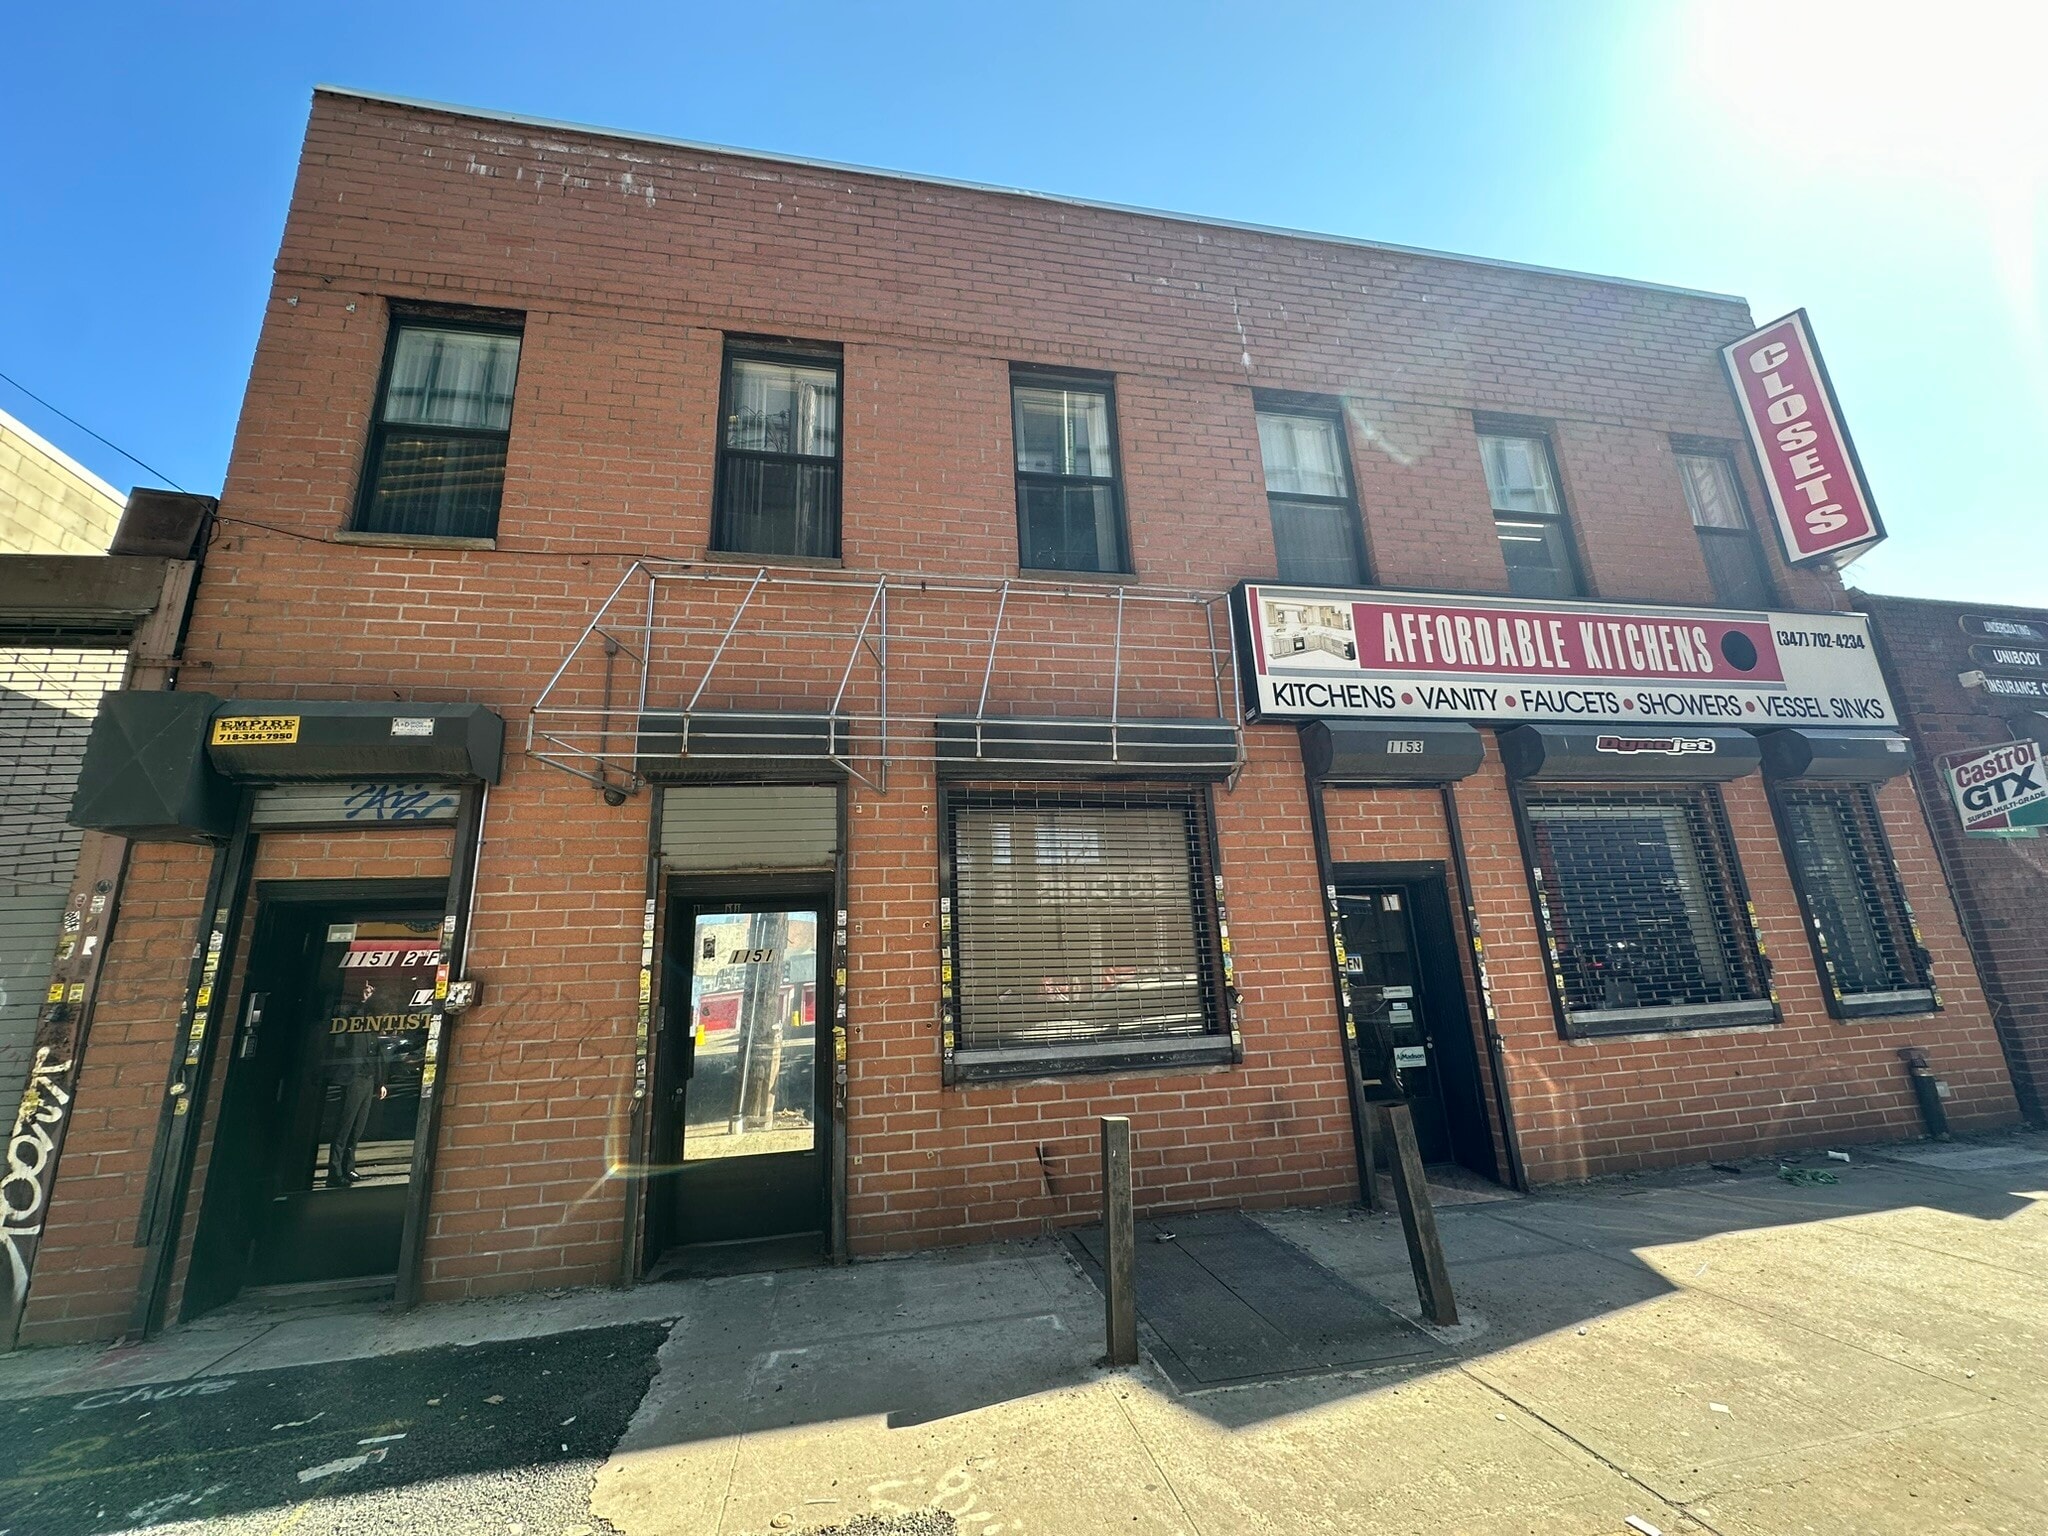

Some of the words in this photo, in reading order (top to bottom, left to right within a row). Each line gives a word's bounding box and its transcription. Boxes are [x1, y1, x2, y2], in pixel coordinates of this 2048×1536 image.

[1748, 341, 1849, 536] CLOSETS
[1381, 611, 1571, 669] AFFORDABLE
[1578, 621, 1714, 673] KITCHENS
[1776, 630, 1809, 647] (347)
[1810, 632, 1866, 649] 702-4234
[1992, 649, 2042, 666] UNIBODY
[1985, 679, 2041, 695] INSURANCE
[1272, 682, 1397, 710] KITCHENS
[1416, 686, 1498, 711] VANITY
[1520, 690, 1620, 714] FAUCETS
[1638, 692, 1742, 716] SHOWERS
[1756, 695, 1828, 719] VESSEL
[1831, 698, 1886, 719] SINKS
[220, 720, 295, 728] EMPIRE
[219, 733, 293, 741] 718-344-7950
[1598, 736, 1714, 753] Dynojet
[1390, 741, 1422, 753] 1153
[1956, 743, 2036, 788] Castrol
[1962, 763, 2042, 811] GTX
[1967, 810, 1993, 824] SUPER
[1993, 790, 2047, 814] MULTI-GRADE
[344, 952, 395, 966] 1151
[732, 949, 773, 963] 1151
